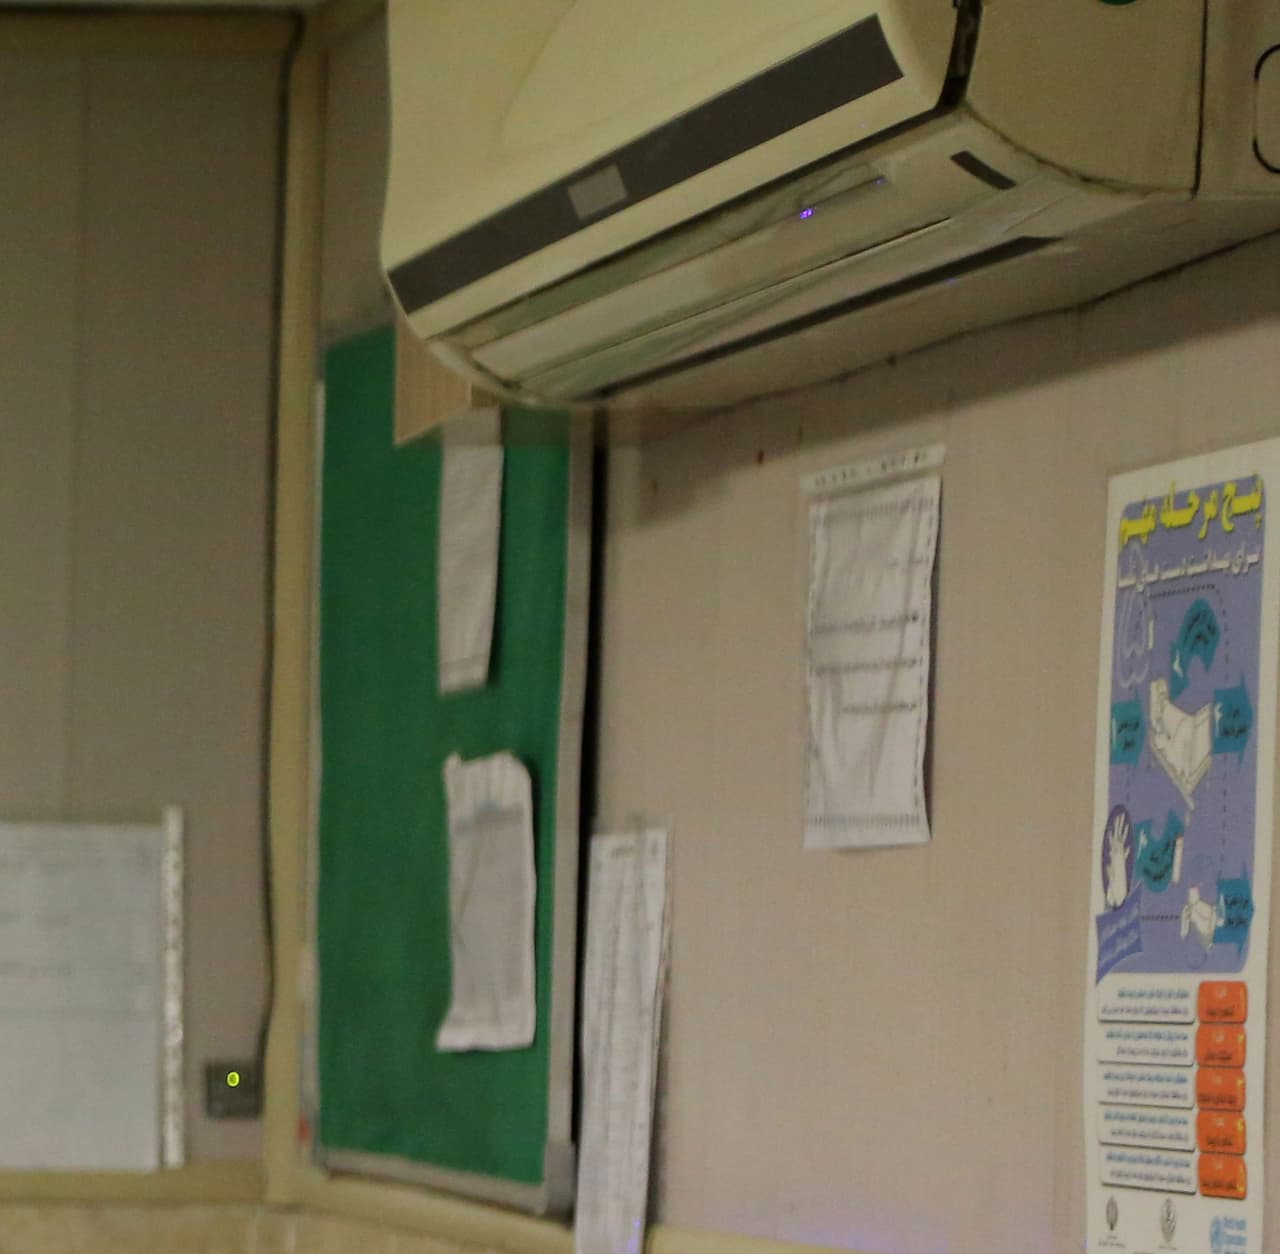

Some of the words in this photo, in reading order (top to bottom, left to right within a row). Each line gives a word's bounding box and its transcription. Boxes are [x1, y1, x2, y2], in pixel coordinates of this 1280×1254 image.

[1119, 501, 1157, 545] مهم
[1159, 480, 1218, 540] مرحله
[1221, 471, 1264, 533] پنج
